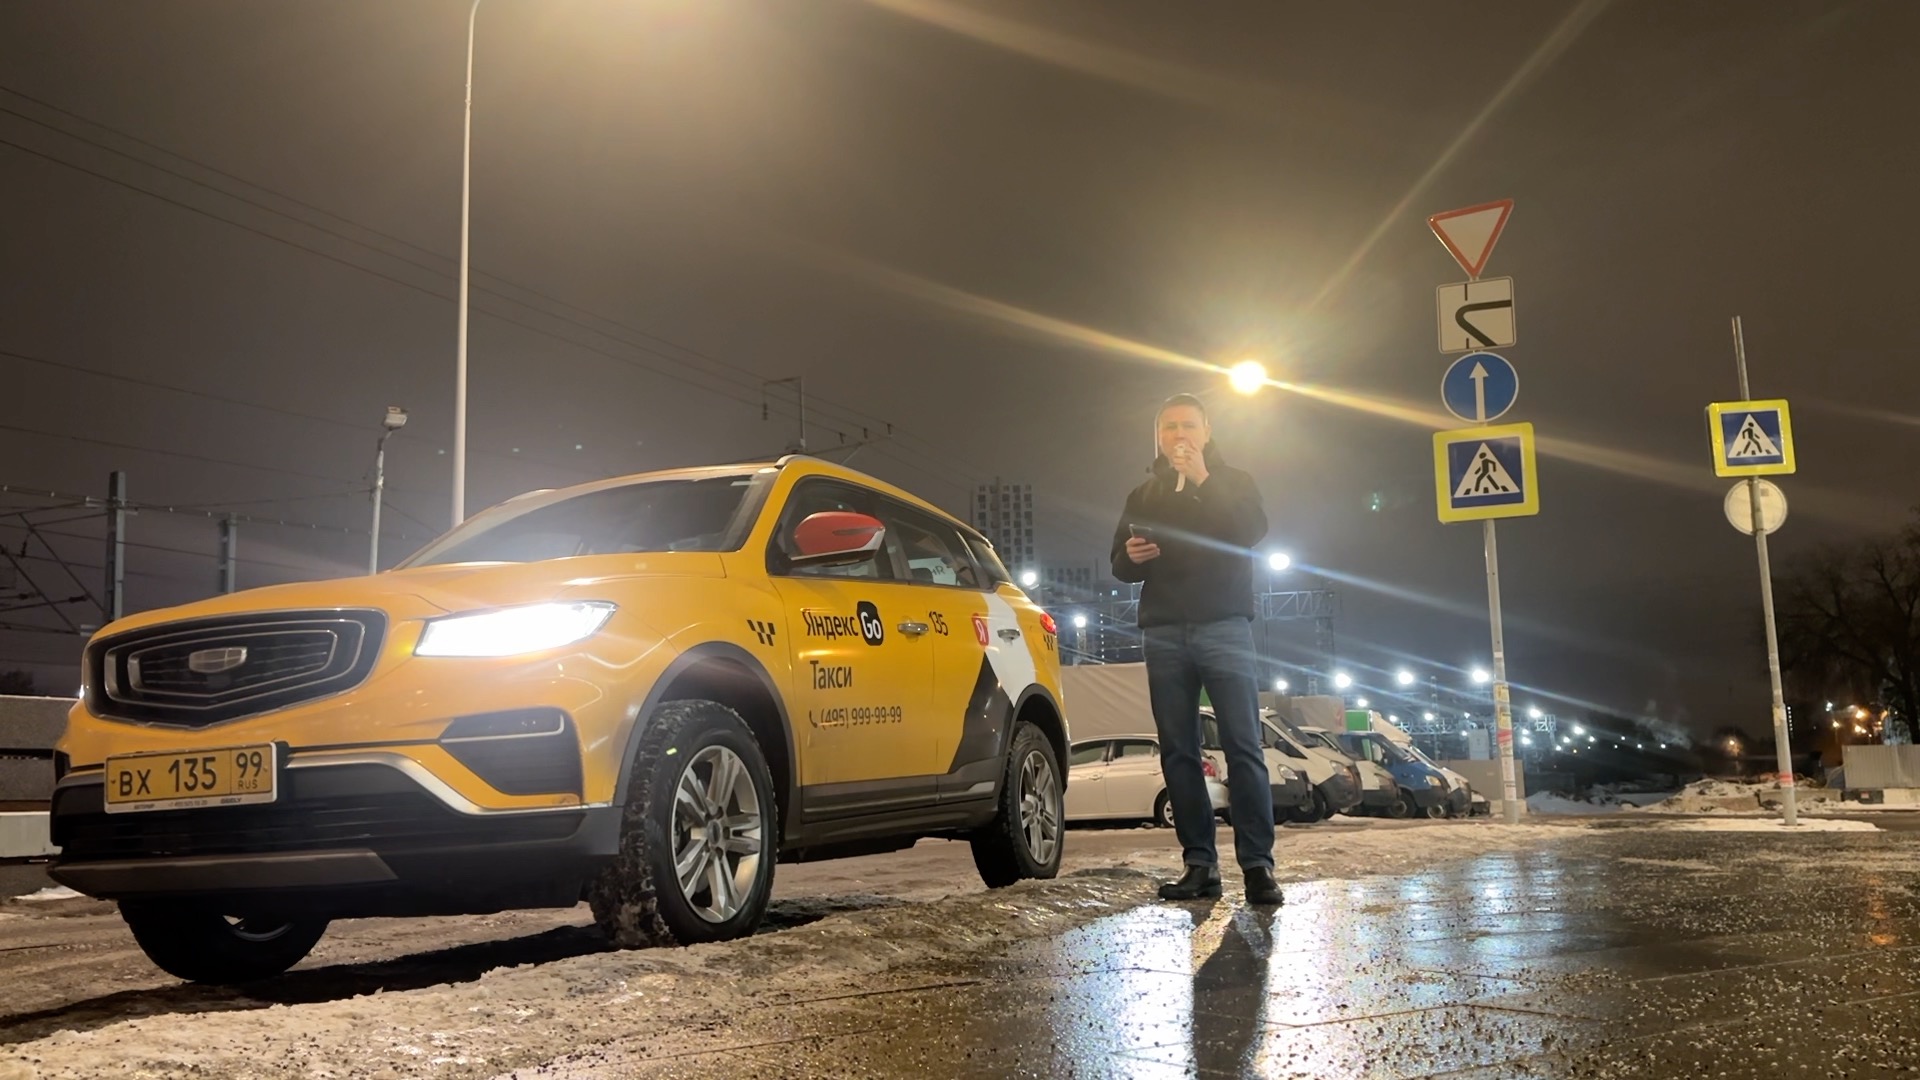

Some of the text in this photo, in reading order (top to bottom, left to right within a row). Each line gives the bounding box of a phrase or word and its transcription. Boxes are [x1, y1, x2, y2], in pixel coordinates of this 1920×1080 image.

[801, 609, 882, 641] Яндекс Go
[929, 611, 948, 636] 135
[974, 619, 987, 643] Я
[809, 659, 853, 690] Такси
[820, 705, 902, 731] (495) 999-99-99
[168, 756, 217, 793] 135
[235, 750, 262, 778] 99
[237, 779, 259, 791] RUS
